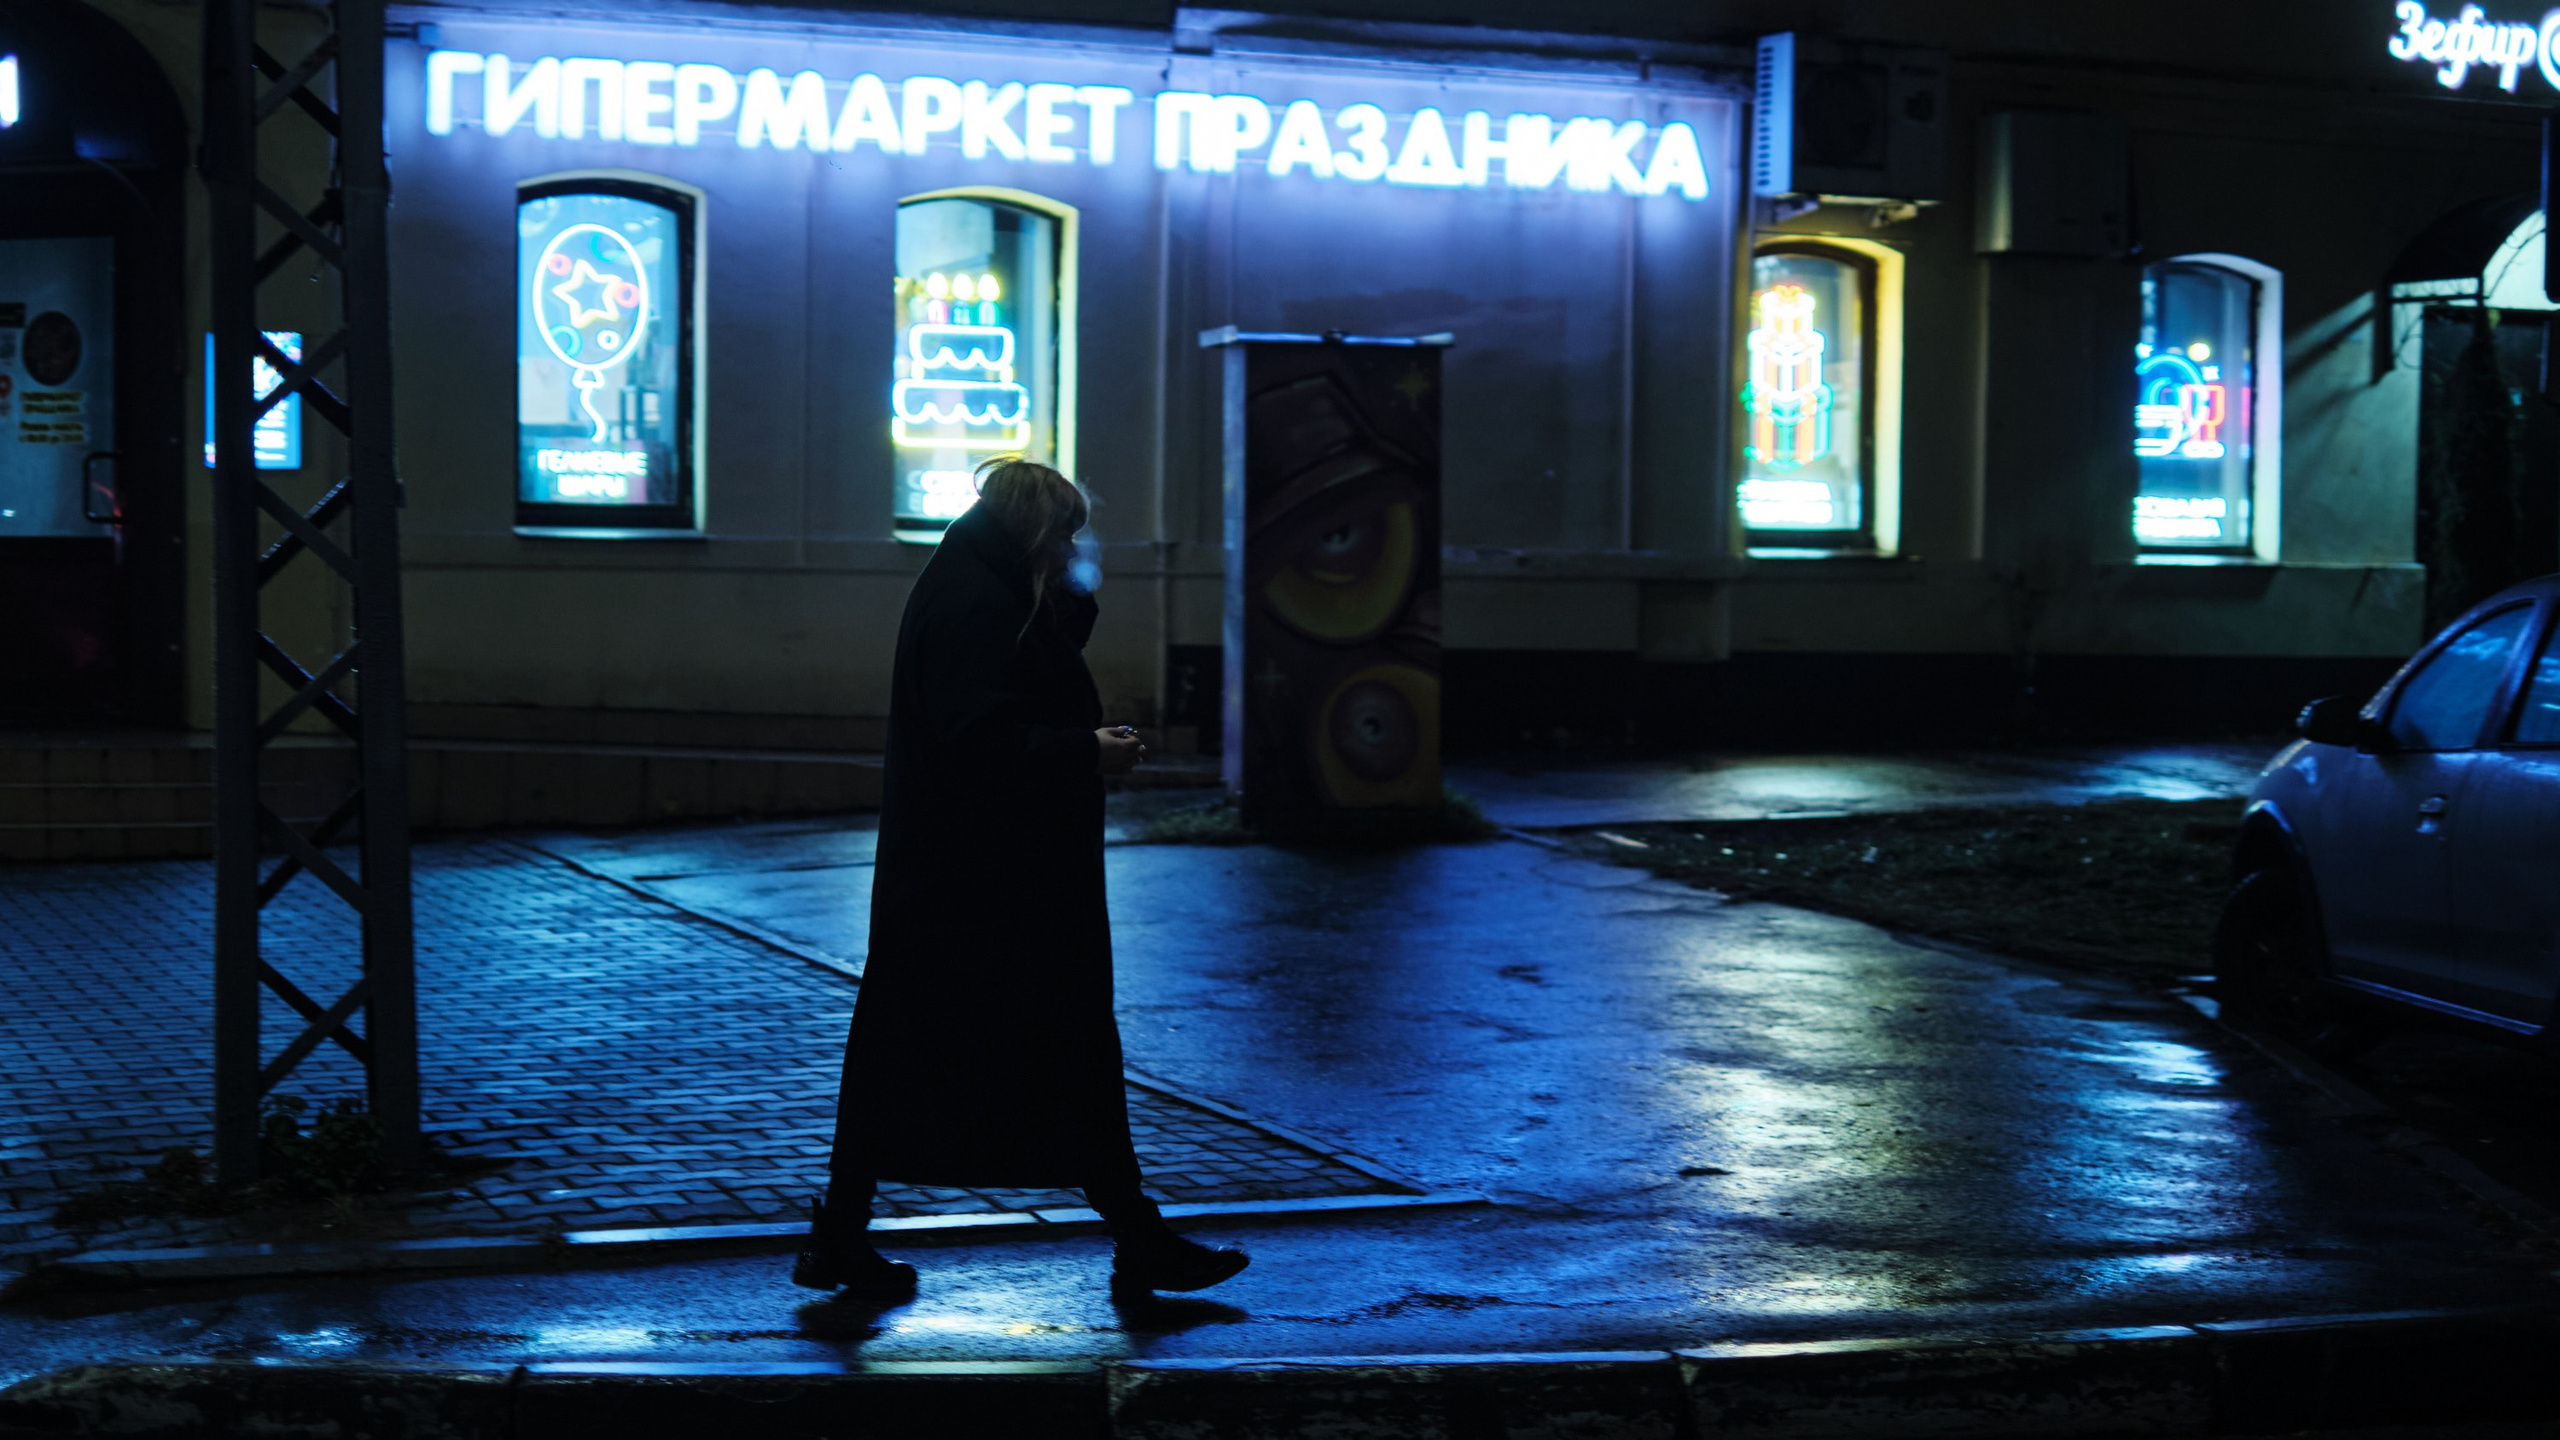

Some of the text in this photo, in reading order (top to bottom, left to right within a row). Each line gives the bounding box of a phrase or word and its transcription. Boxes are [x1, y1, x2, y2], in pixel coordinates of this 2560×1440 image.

[2388, 0, 2538, 92] Зефир
[425, 50, 1710, 201] ГИПЕРМАРКЕТ ПРАЗДНИКА
